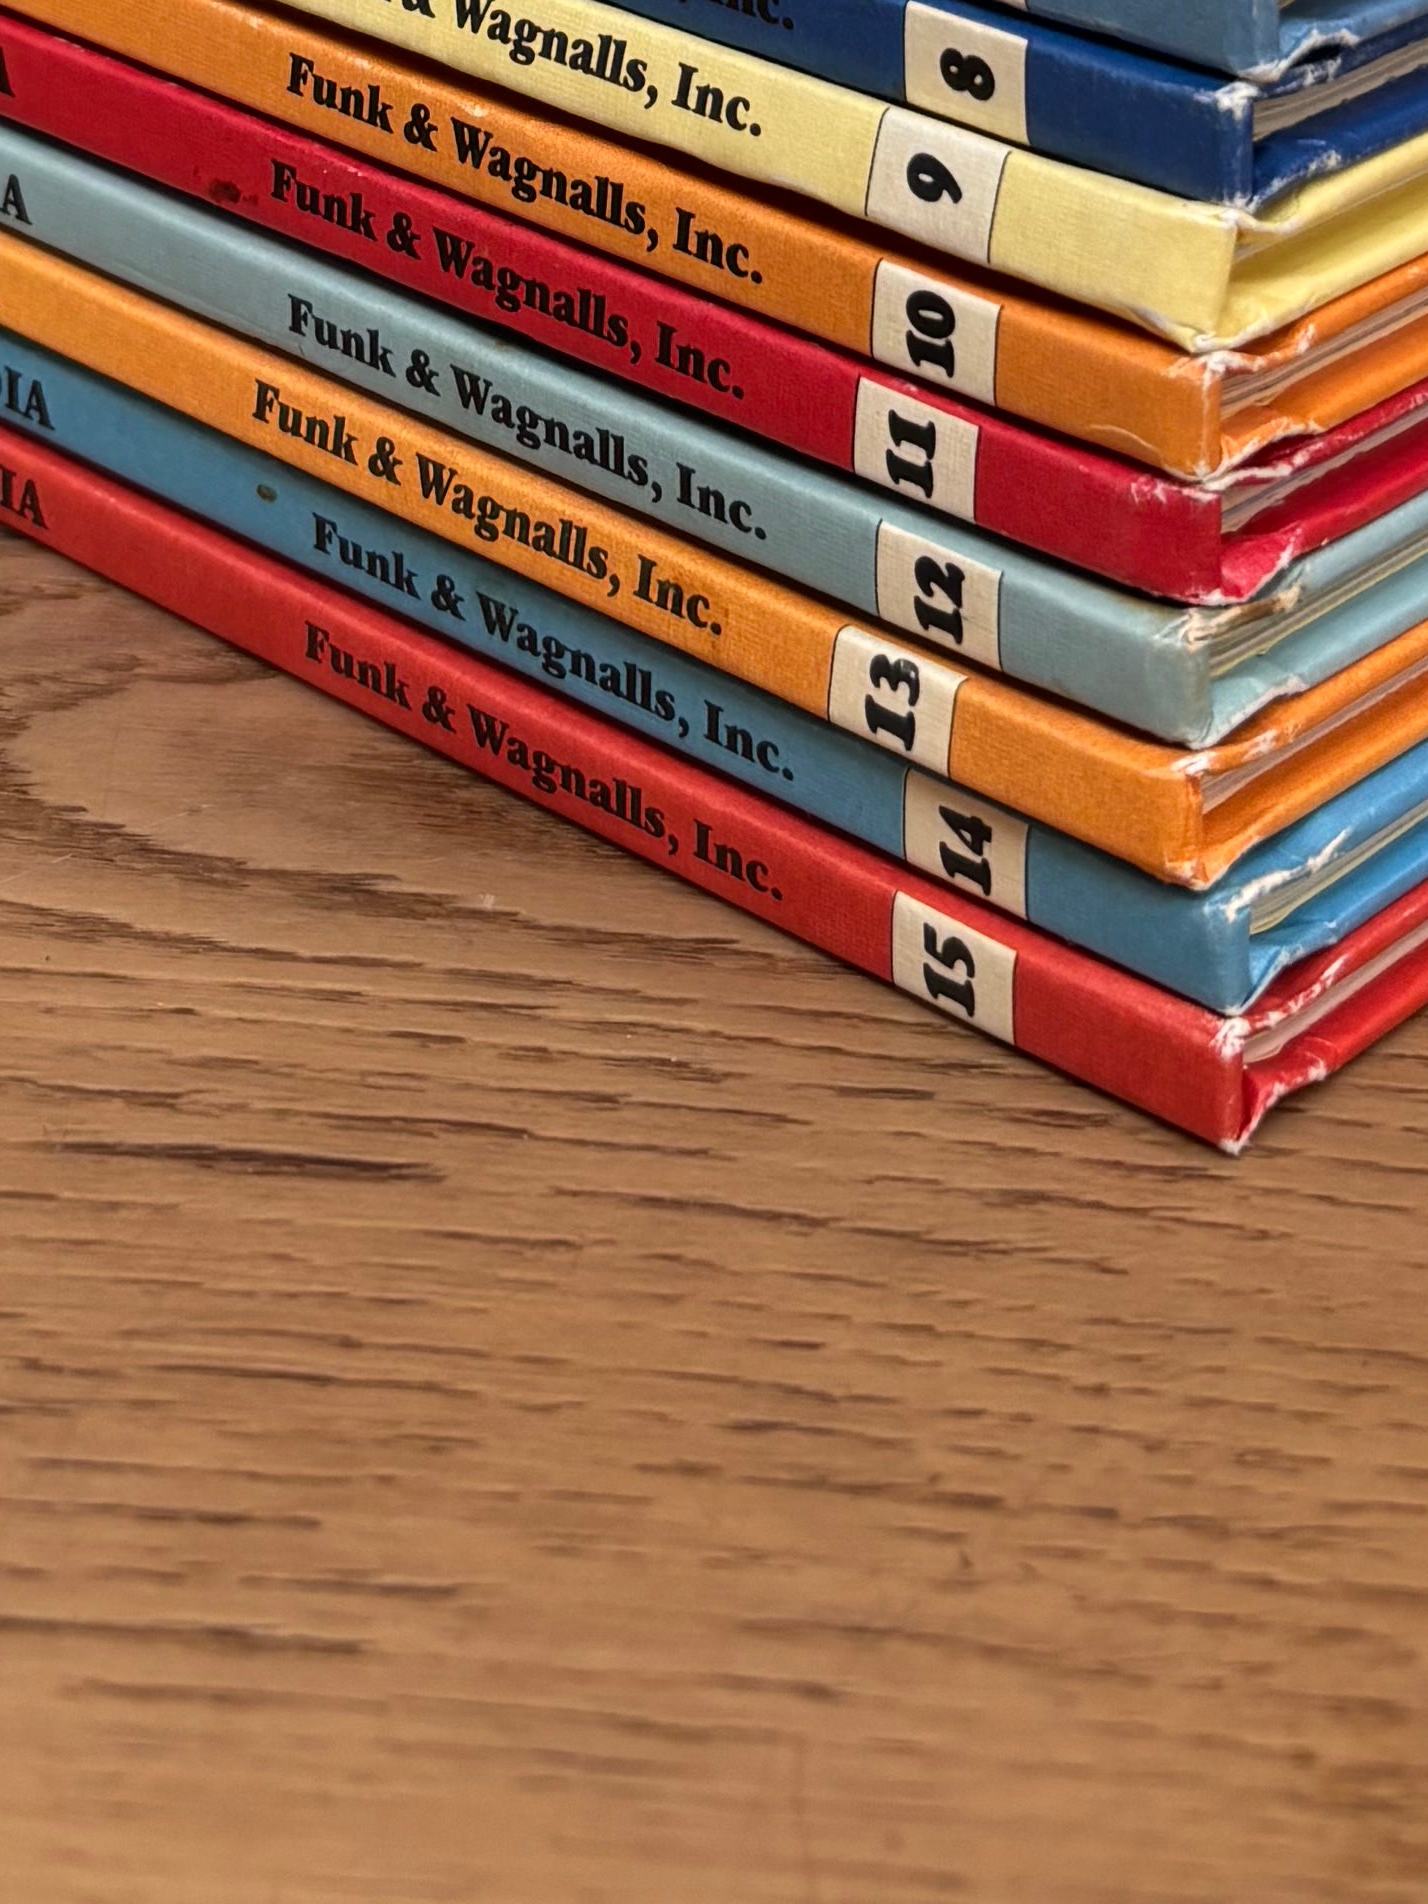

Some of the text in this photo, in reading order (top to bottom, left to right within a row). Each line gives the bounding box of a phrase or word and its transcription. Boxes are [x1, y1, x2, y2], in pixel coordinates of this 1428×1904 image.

[671, 62, 762, 137] Inc.
[939, 47, 996, 102] 8
[286, 52, 763, 285] Funk & Wagnalls, Inc.
[906, 152, 963, 204] 9
[271, 159, 744, 400] Funk & Wagnalls, Inc.
[905, 290, 956, 379] 10
[288, 293, 767, 541] Funk & Wagnalls, Inc.
[885, 409, 937, 499] 11
[252, 379, 722, 636] Funk & Wagnalls, Inc.
[313, 512, 794, 781] Funk & Wagnalls, Inc.
[913, 555, 966, 645] 12
[864, 654, 921, 752] 13
[305, 623, 782, 901] Funk & Wagnalls, Inc.
[938, 805, 993, 897] 14
[923, 923, 976, 1018] 15
